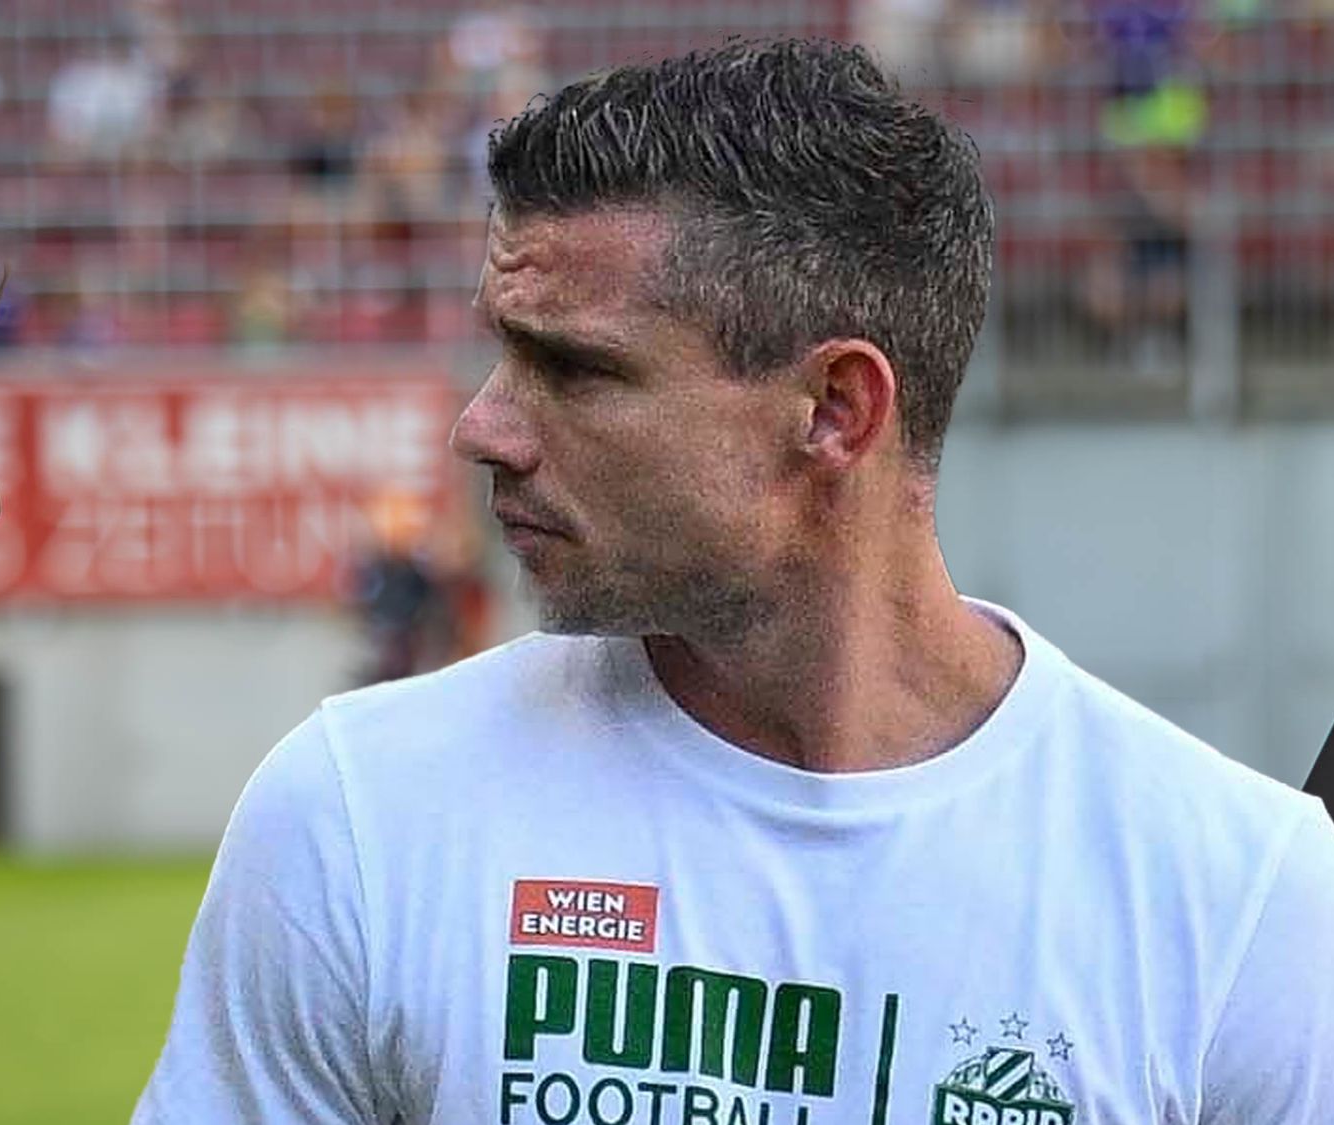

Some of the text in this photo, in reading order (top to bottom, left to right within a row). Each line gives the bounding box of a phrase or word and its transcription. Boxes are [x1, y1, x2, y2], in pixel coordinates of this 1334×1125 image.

[546, 889, 625, 913] WIEN
[521, 913, 645, 942] ENERGIE
[503, 953, 842, 1098] PUMA
